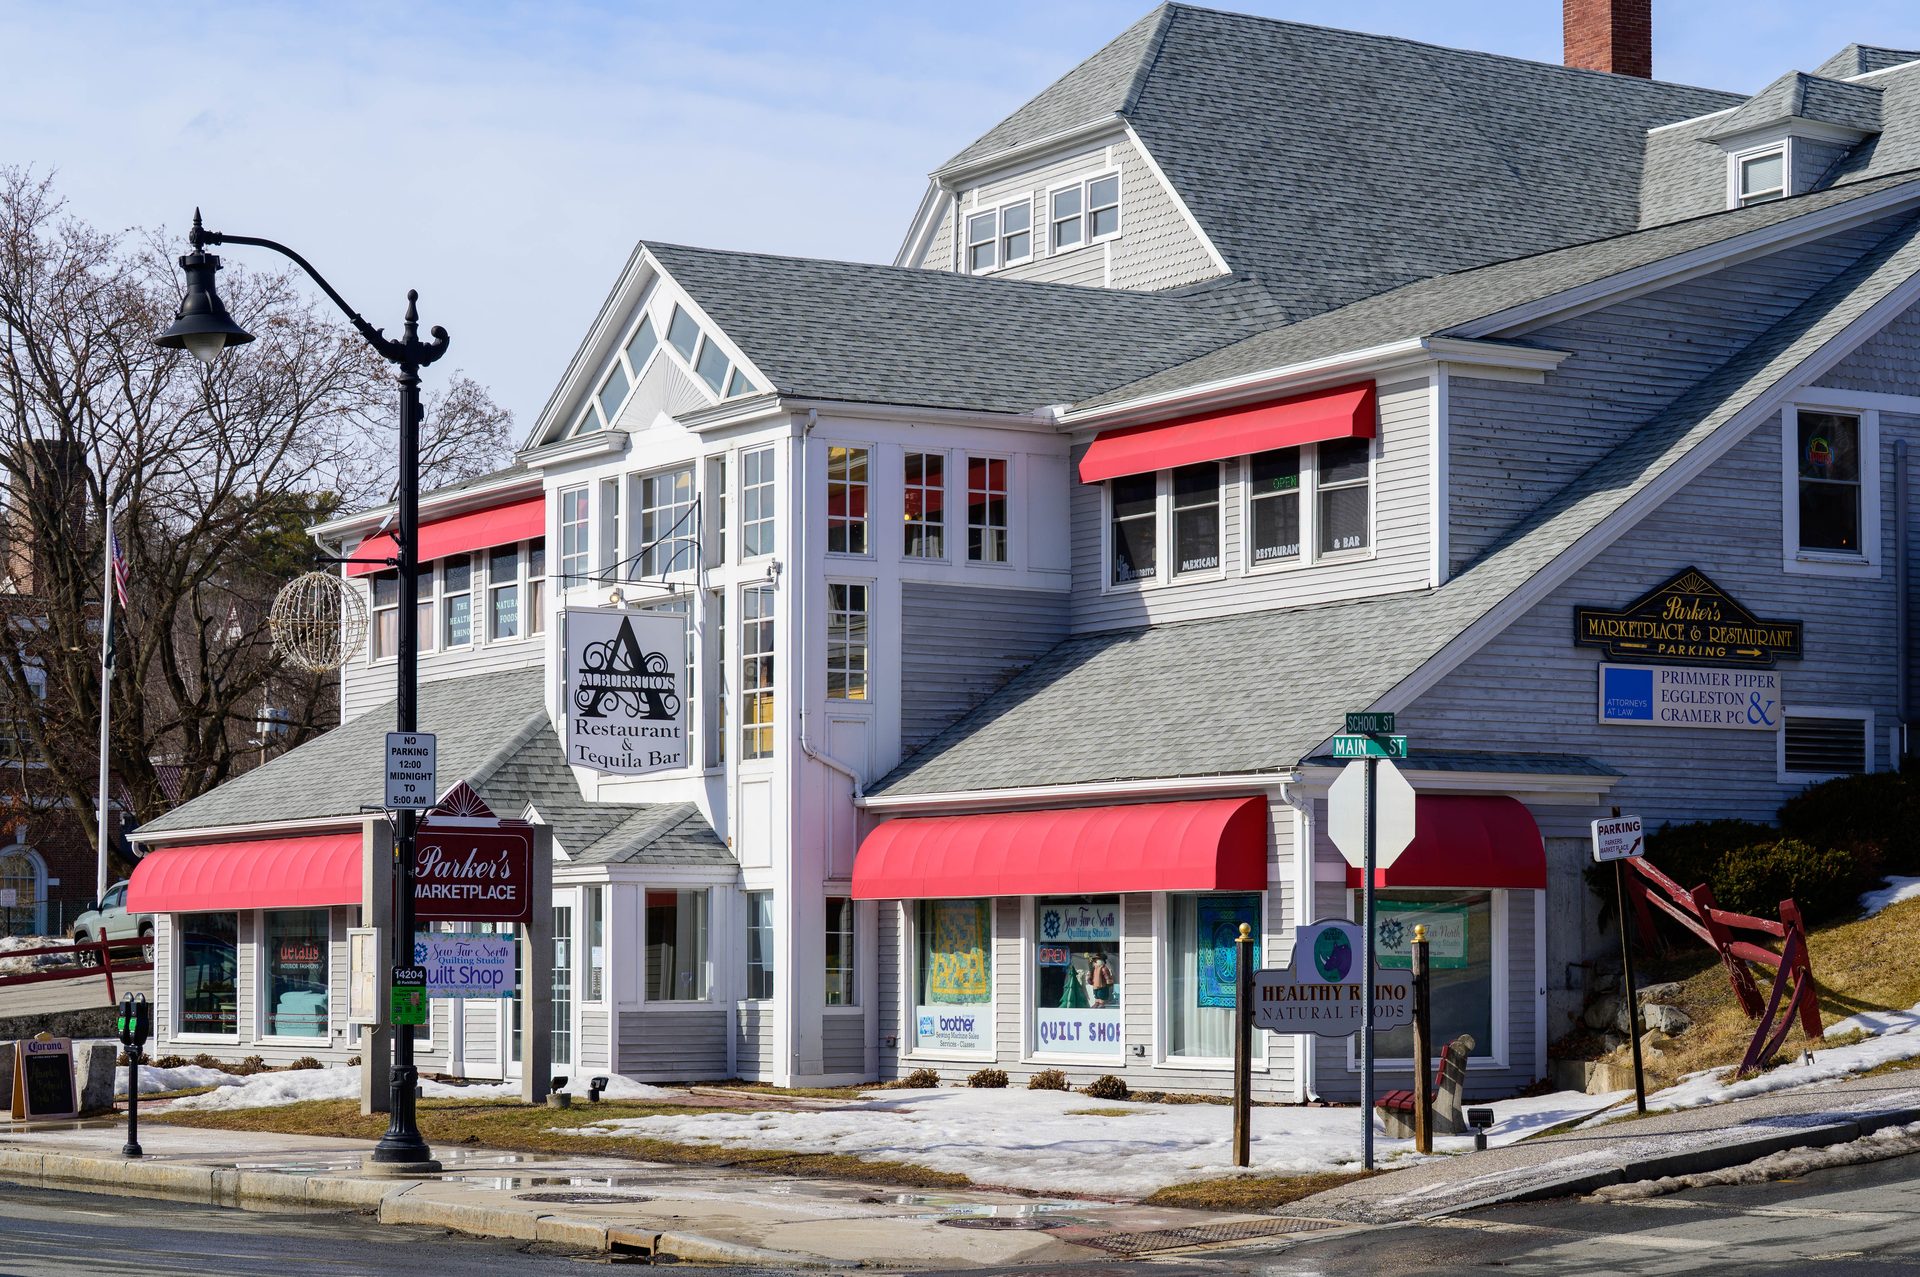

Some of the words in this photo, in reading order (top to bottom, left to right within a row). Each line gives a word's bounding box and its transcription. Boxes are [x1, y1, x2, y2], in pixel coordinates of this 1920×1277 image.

[1273, 475, 1297, 489] OPEN
[1333, 538, 1340, 549] &
[1343, 535, 1360, 548] BAR
[1182, 556, 1218, 571] MEXICAN
[457, 601, 468, 611] THE
[496, 599, 518, 610] NATURA
[1662, 596, 1721, 622] Parker's
[449, 614, 471, 625] HEALTH
[1588, 618, 1685, 641] MARKETPLACE
[1690, 625, 1702, 641] &
[1709, 626, 1793, 647] RESTAURANT
[1658, 644, 1726, 657] PARKING
[580, 673, 676, 691] ALBURRITO'S
[1661, 670, 1731, 687] PRIMMER
[1735, 674, 1776, 689] PIPER
[1607, 698, 1648, 708] ATTORNEYS
[1661, 689, 1745, 706] EGGLESTON
[1747, 691, 1776, 727] &
[1617, 709, 1634, 717] LAW
[1661, 707, 1722, 724] CRAMER
[1726, 710, 1744, 725] PC
[574, 718, 680, 739] Restaurant
[1348, 715, 1379, 731] SCHOOL
[1383, 715, 1393, 731] ST
[404, 736, 417, 745] NO
[621, 737, 634, 751] &
[1335, 738, 1367, 755] MAIN
[1388, 738, 1404, 755] ST
[391, 747, 429, 756] PARKING
[575, 744, 642, 768] Tequila
[649, 750, 680, 767] Bar
[389, 772, 432, 780] MIDNIGHT
[404, 784, 416, 792] TO
[393, 796, 411, 804] 5:00
[413, 796, 426, 804] AM
[1598, 821, 1640, 836] PARKING
[1604, 838, 1622, 846] PARKERS
[415, 845, 512, 878] Parker's
[1067, 928, 1091, 940] Quilting
[1092, 928, 1112, 938] Studio
[431, 943, 452, 960] Sew
[455, 942, 473, 957] Far
[475, 943, 508, 957] North
[1040, 948, 1067, 962] OPEN
[438, 956, 474, 965] Quilting
[476, 956, 505, 965] Studio
[395, 970, 423, 979] 14204
[426, 966, 455, 984] uilt
[459, 966, 504, 989] Shop
[1262, 985, 1342, 1001] HEALTHY
[1349, 984, 1406, 1000] RINO
[1262, 1006, 1343, 1020] NATURAL
[940, 1015, 975, 1032] brother
[1041, 1021, 1082, 1044] QUILT
[28, 1041, 63, 1053] Corona
